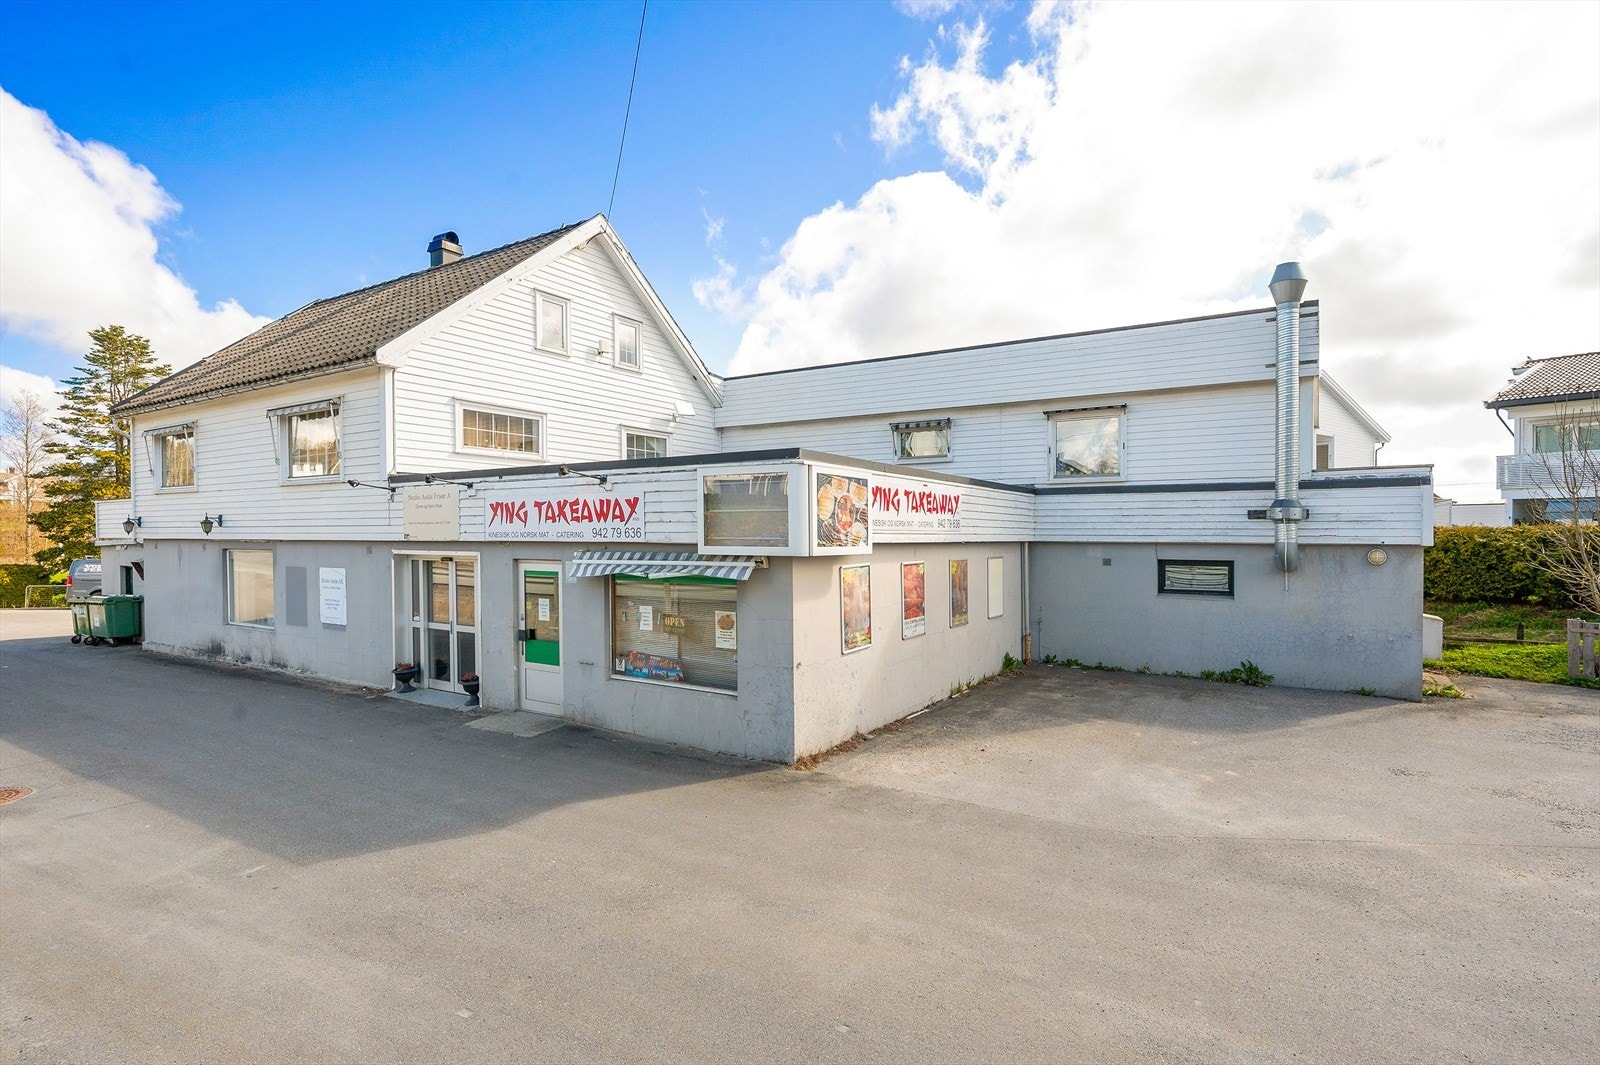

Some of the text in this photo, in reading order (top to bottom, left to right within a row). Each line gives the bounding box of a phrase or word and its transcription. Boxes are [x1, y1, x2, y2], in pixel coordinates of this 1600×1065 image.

[872, 486, 960, 518] YING TAKEAWAY
[488, 496, 640, 528] YING TAKEAWAY
[938, 518, 946, 528] 942
[947, 519, 952, 528] 79
[488, 531, 510, 539] KINESISK
[511, 531, 519, 539] OG
[519, 531, 537, 539] NORSK
[538, 531, 549, 539] MAT
[556, 531, 585, 539] CATERING
[592, 527, 608, 539] 942
[611, 527, 622, 539] 79
[624, 527, 642, 539] 636
[664, 616, 685, 628] OPEN
